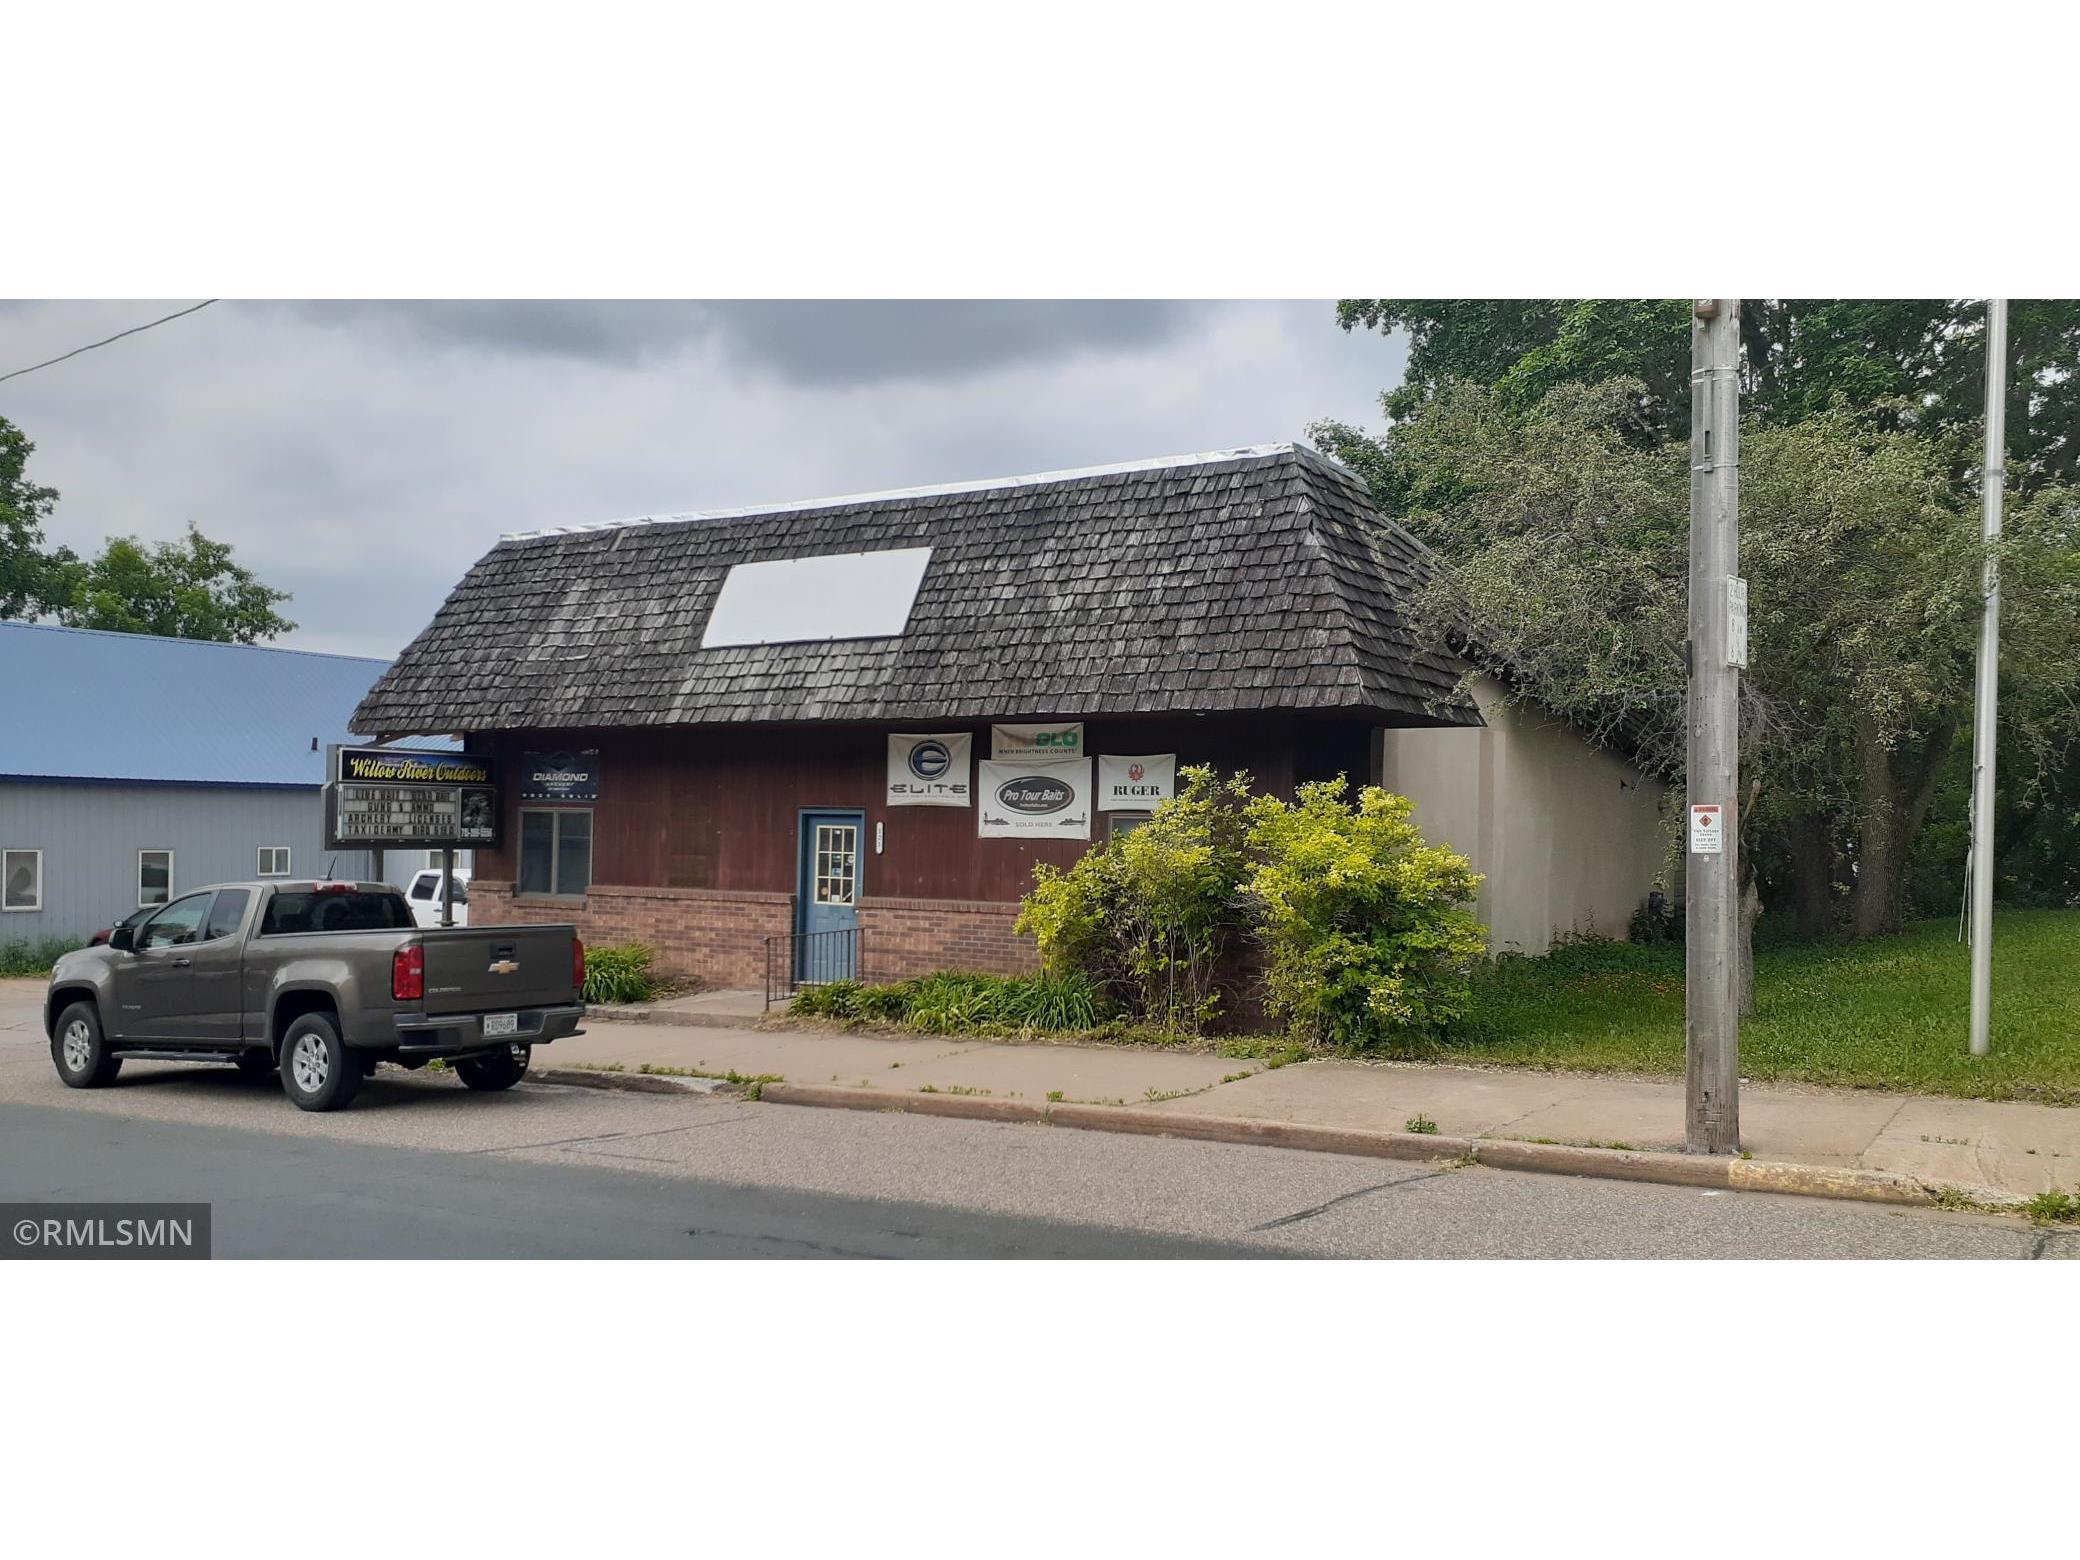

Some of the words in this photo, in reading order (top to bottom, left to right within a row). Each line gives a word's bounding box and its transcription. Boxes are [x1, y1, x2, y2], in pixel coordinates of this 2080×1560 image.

[350, 758, 395, 778] Willow
[397, 759, 434, 780] River
[436, 761, 487, 781] Outdoors
[532, 772, 589, 782] DIAMOND
[890, 784, 967, 794] ELITE
[1112, 785, 1160, 796] RUGER
[1003, 789, 1019, 801] Pro
[1020, 789, 1041, 801] Tour
[1041, 789, 1065, 801] Baits
[368, 801, 392, 812] GUNS
[411, 801, 434, 813] AMMO
[348, 813, 392, 824] ARCHERY
[409, 814, 452, 825] LICENSES
[348, 825, 403, 836] TAXIDERMY
